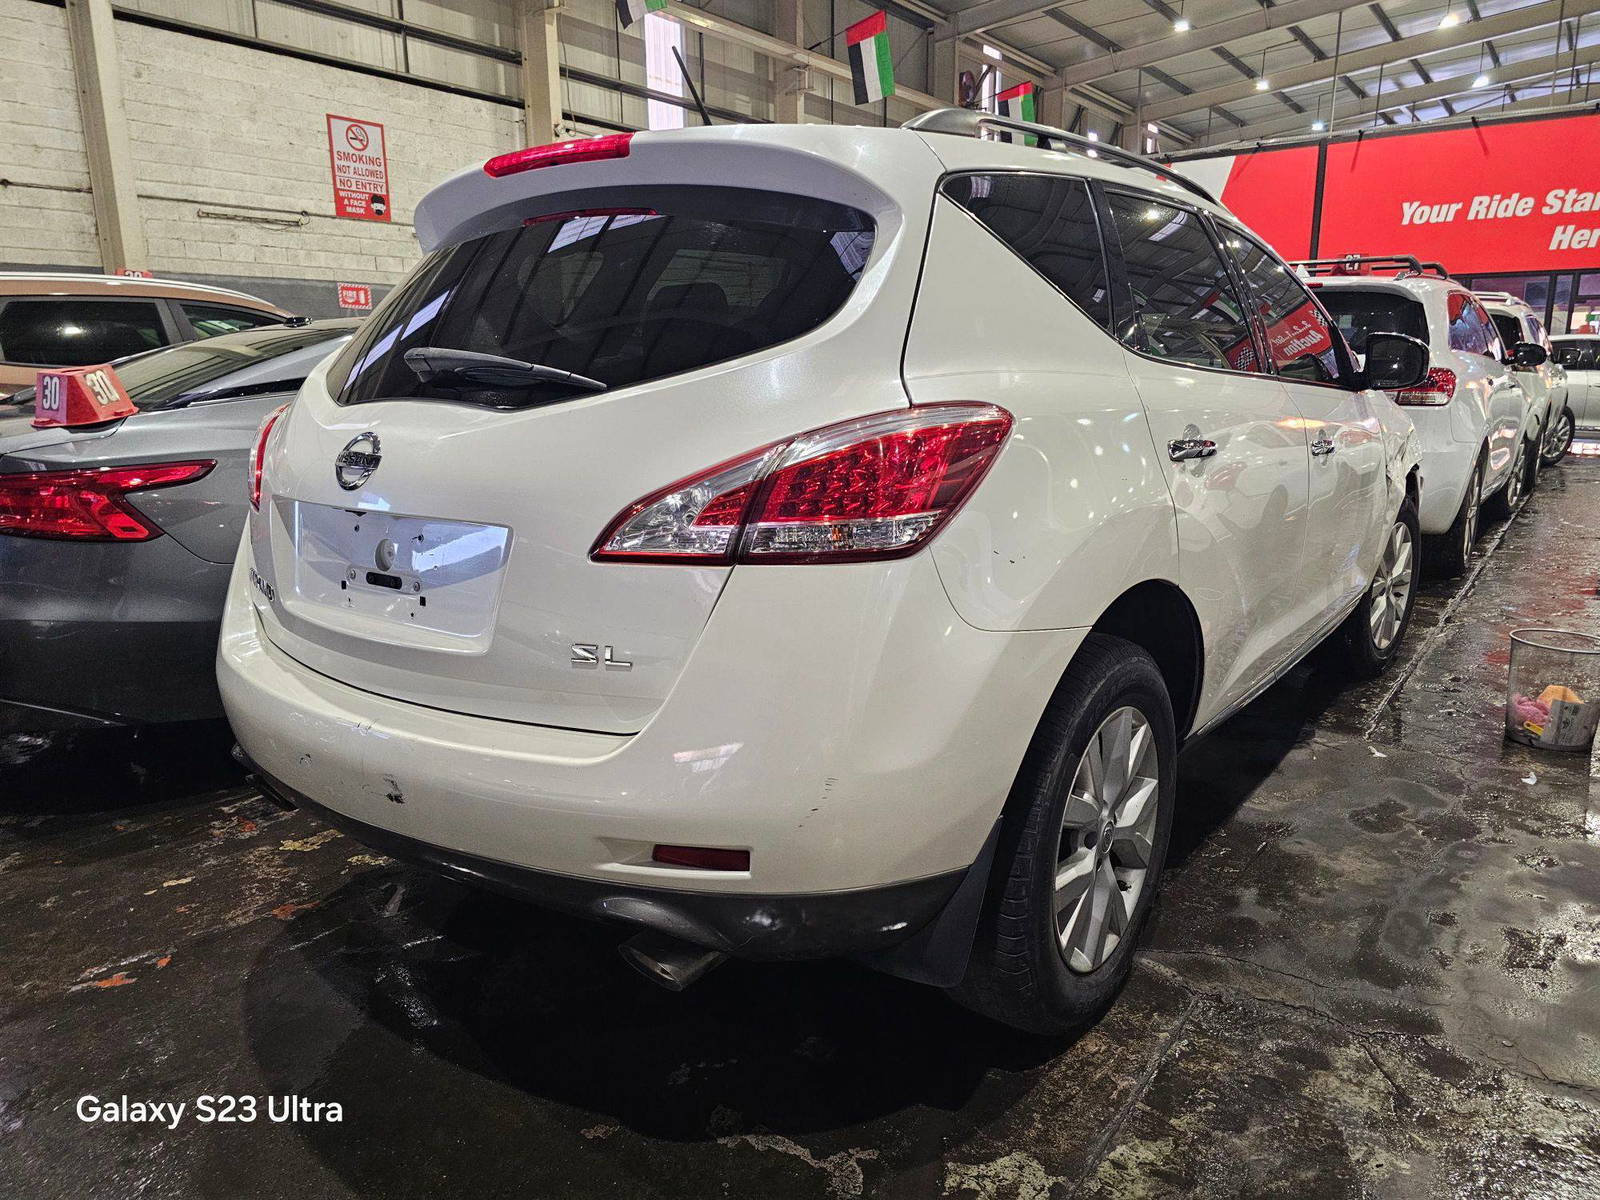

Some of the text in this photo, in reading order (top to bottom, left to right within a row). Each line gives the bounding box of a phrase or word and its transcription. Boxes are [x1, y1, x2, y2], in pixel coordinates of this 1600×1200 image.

[336, 150, 382, 167] SMOKING
[336, 164, 384, 180] NOT ALLOWED
[339, 178, 384, 193] NO ENTRY
[338, 190, 369, 200] WITHOUT
[345, 206, 366, 215] MASK
[350, 199, 367, 208] FACE
[1401, 201, 1463, 226] Your
[1467, 192, 1535, 221] Ride
[42, 376, 60, 410] 30
[85, 369, 121, 405] 30
[571, 643, 633, 667] SL
